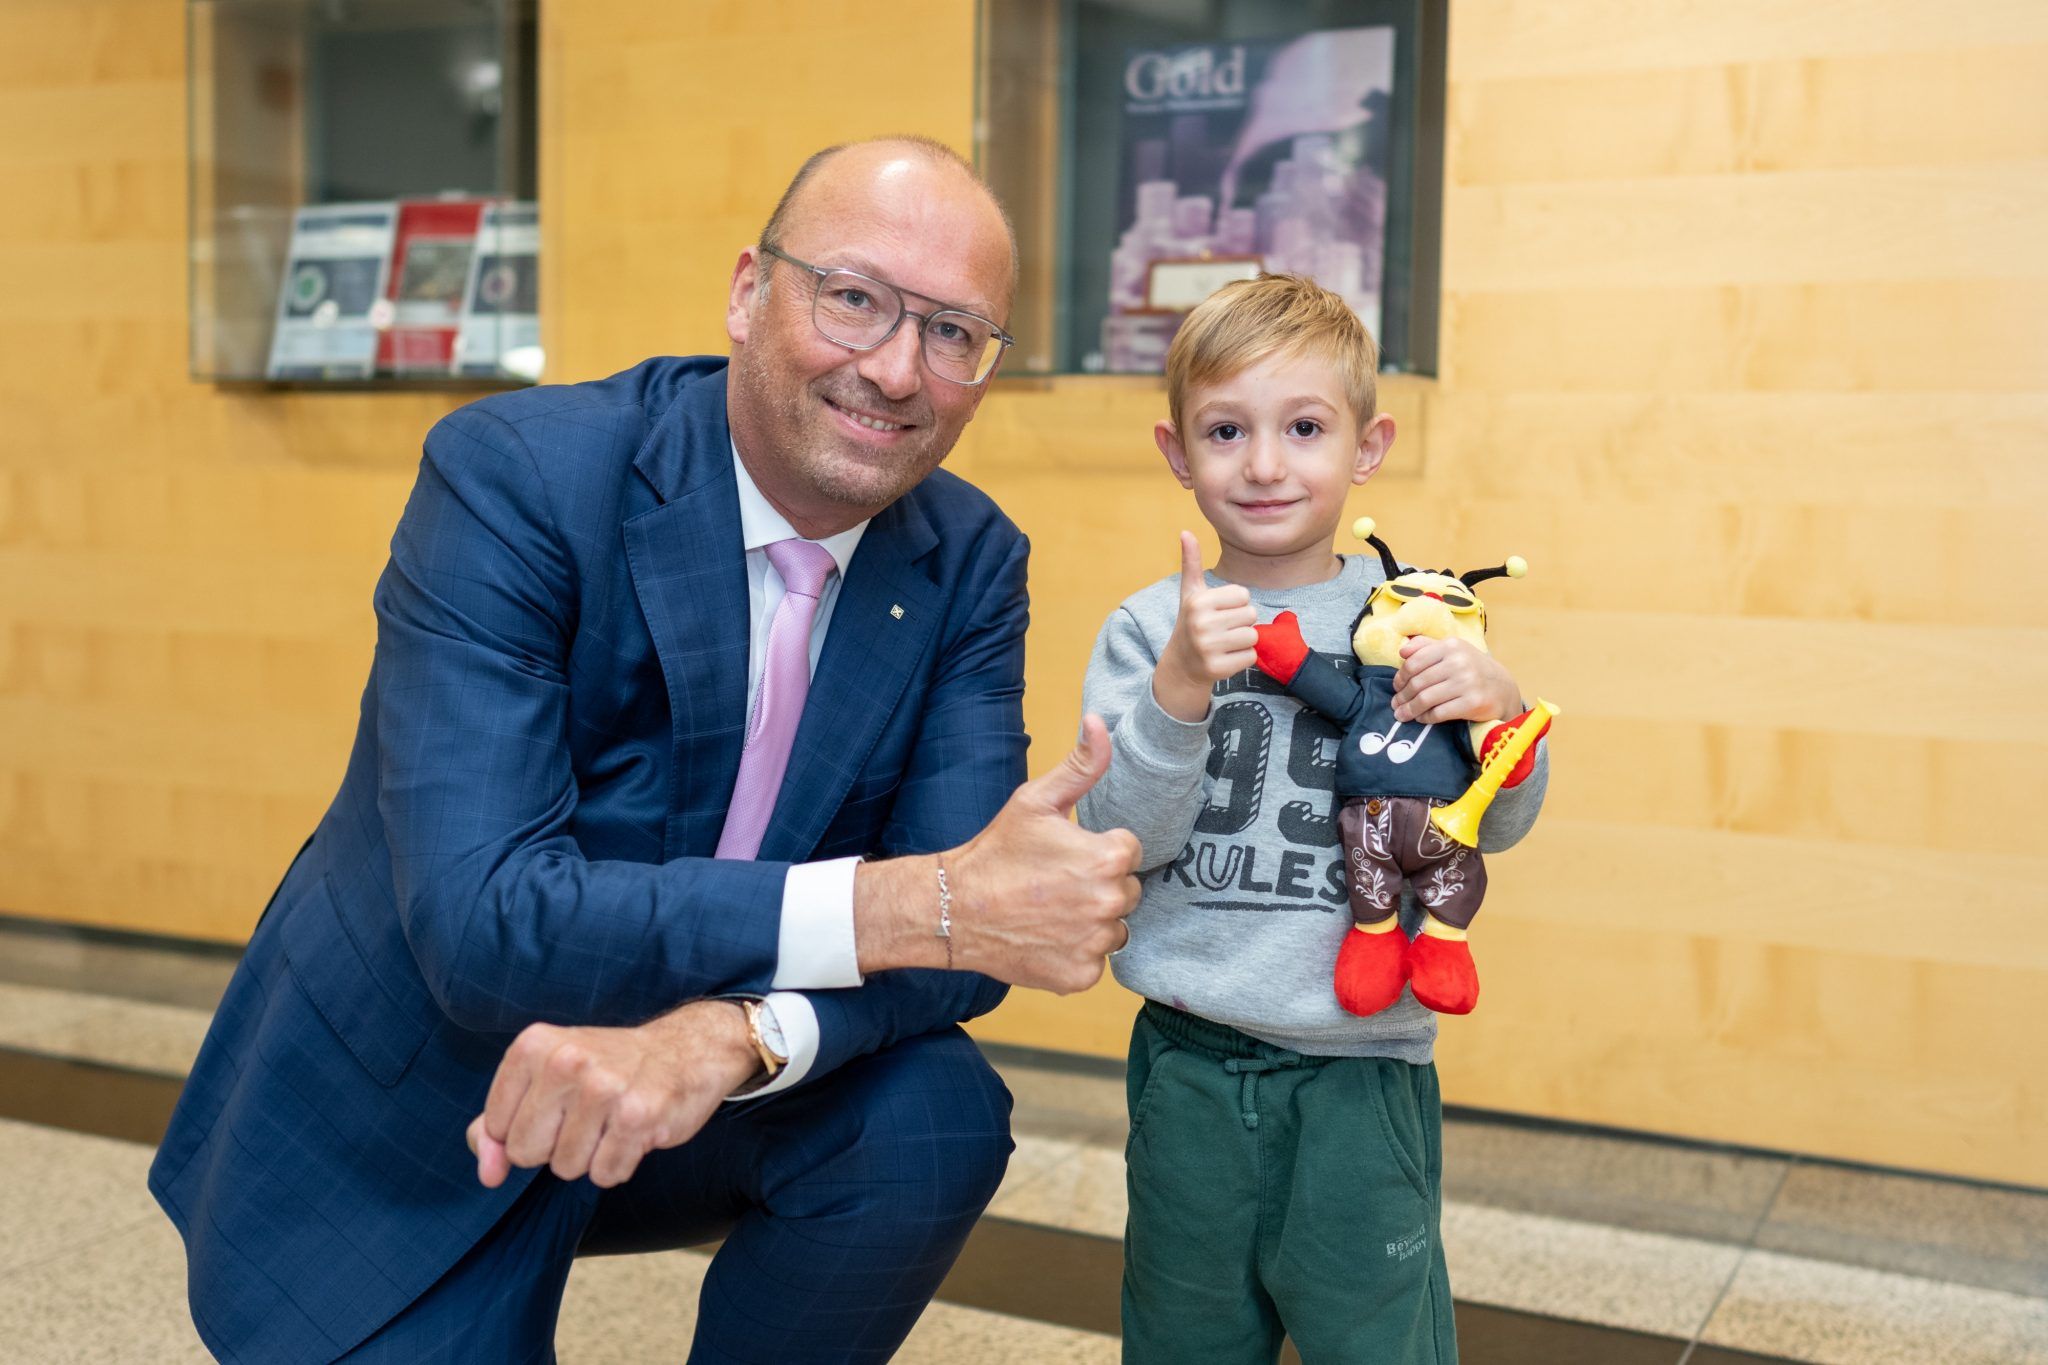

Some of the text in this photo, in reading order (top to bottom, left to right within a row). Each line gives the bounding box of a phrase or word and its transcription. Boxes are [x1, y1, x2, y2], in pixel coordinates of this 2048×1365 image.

[1124, 45, 1245, 98] Gold
[1194, 700, 1344, 848] 95
[1162, 841, 1349, 905] RULES
